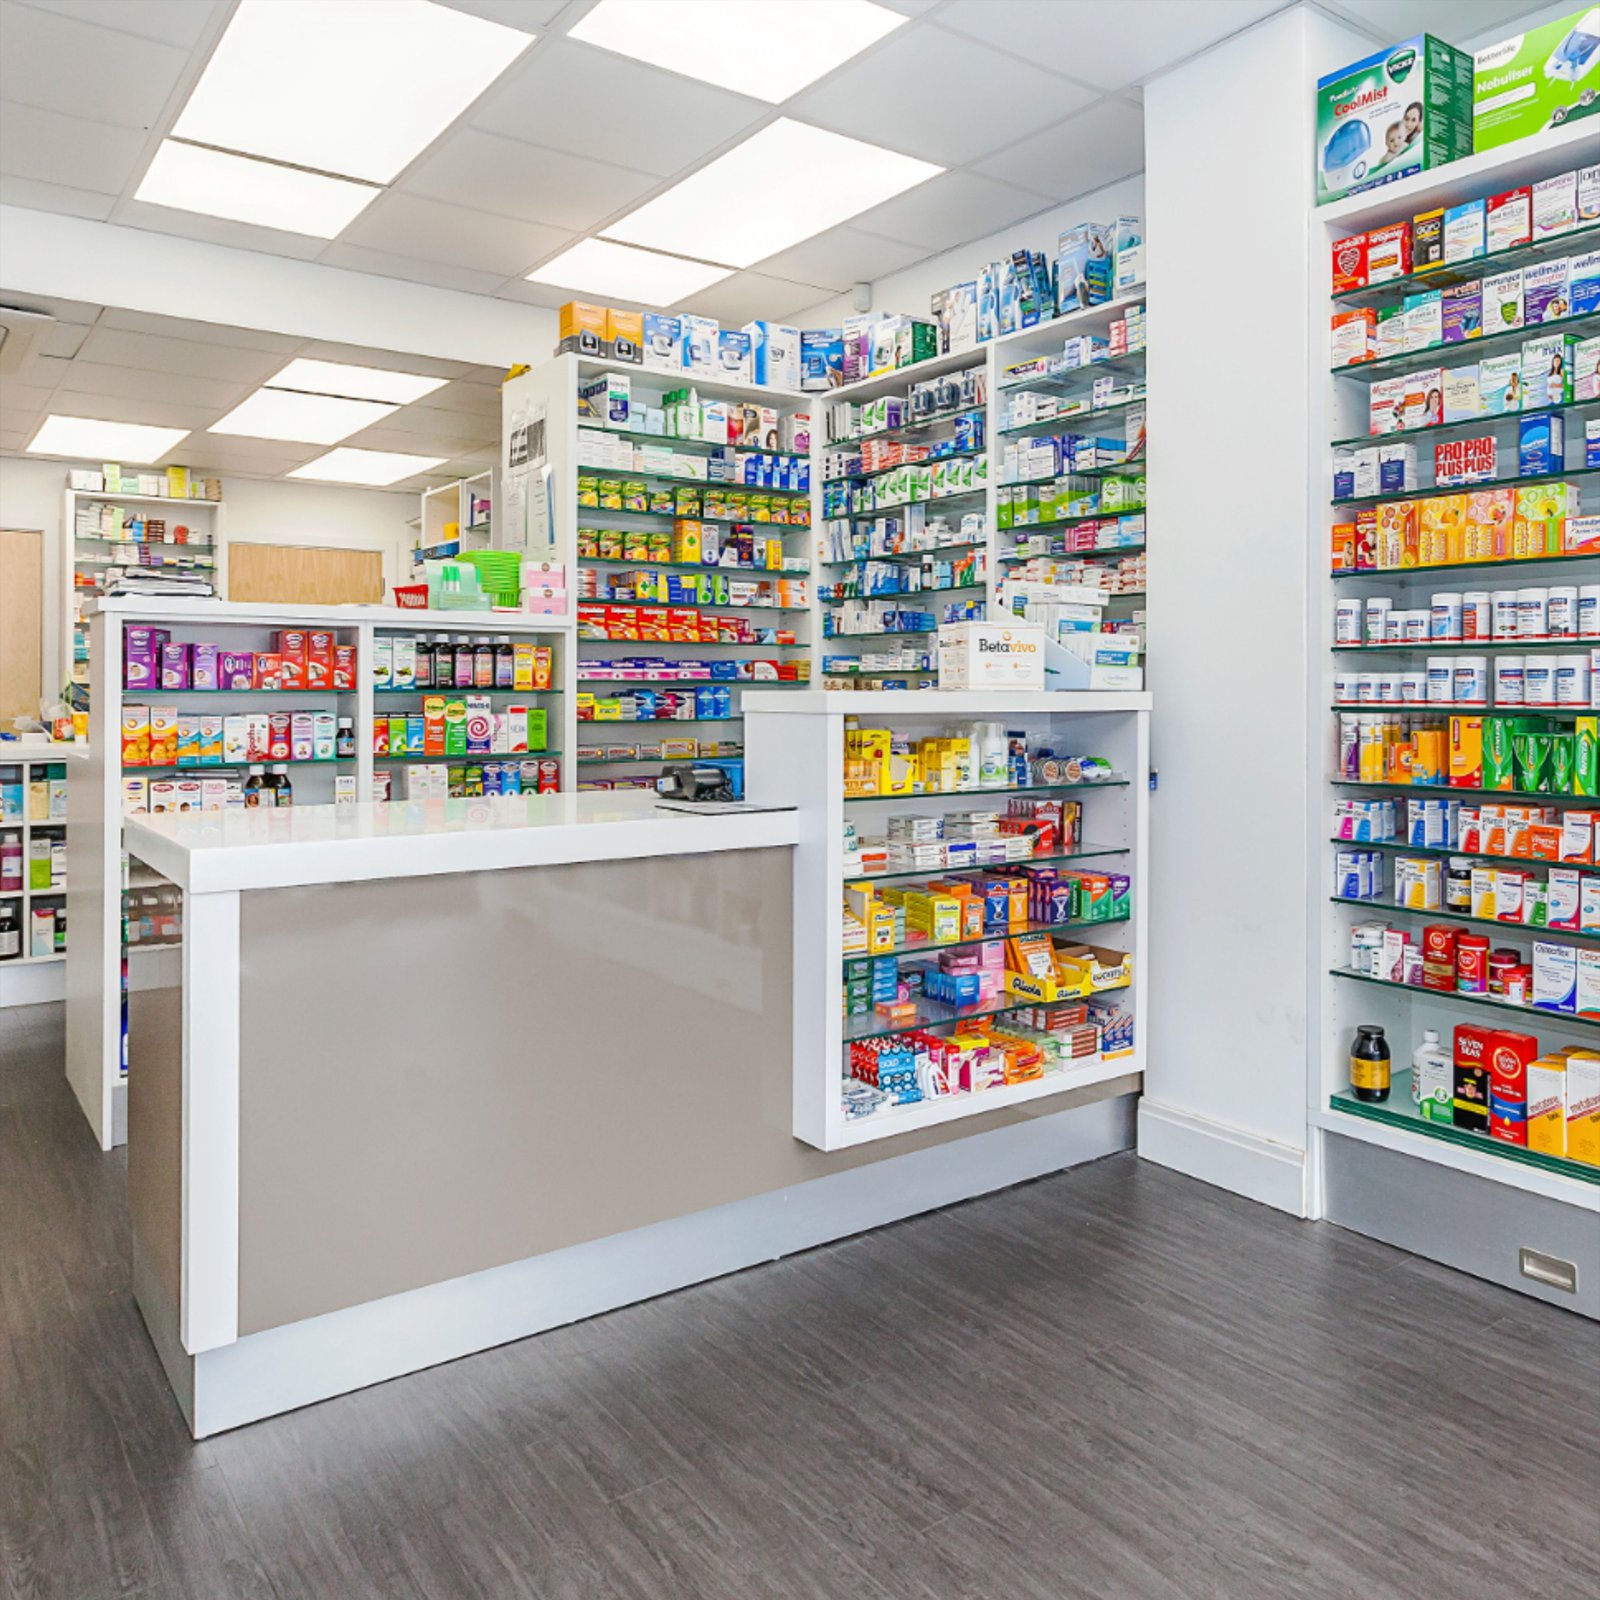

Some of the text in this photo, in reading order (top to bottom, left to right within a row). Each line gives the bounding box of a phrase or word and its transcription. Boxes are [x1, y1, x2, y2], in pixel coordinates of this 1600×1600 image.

[1390, 57, 1413, 74] VICKS
[1476, 65, 1534, 94] Nebuliser
[1333, 85, 1389, 117] CoolMist
[1525, 263, 1566, 280] wellman
[1435, 437, 1492, 463] PRO PRO
[1435, 456, 1492, 477] PLUS PLUS
[978, 638, 1037, 653] Betavivo
[1013, 977, 1042, 997] Ricola
[1057, 988, 1081, 998] Ricola
[1458, 1036, 1484, 1051] SEVEN
[1461, 1046, 1481, 1058] SEAS
